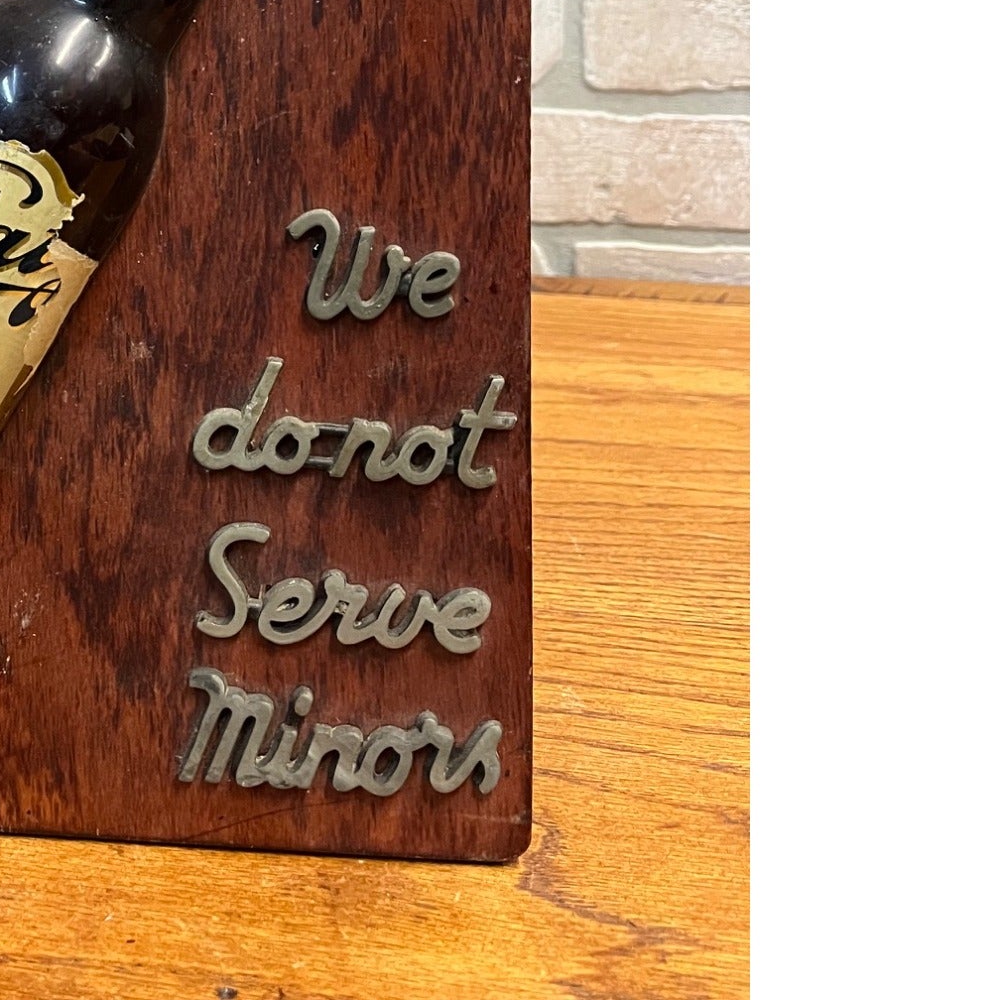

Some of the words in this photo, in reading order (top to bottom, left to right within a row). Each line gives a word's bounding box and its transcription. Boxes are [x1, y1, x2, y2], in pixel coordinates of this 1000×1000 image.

[286, 208, 461, 320] We
[192, 356, 320, 475] do
[329, 374, 518, 489] not
[196, 521, 492, 654] Serve
[177, 666, 503, 797] Minors
